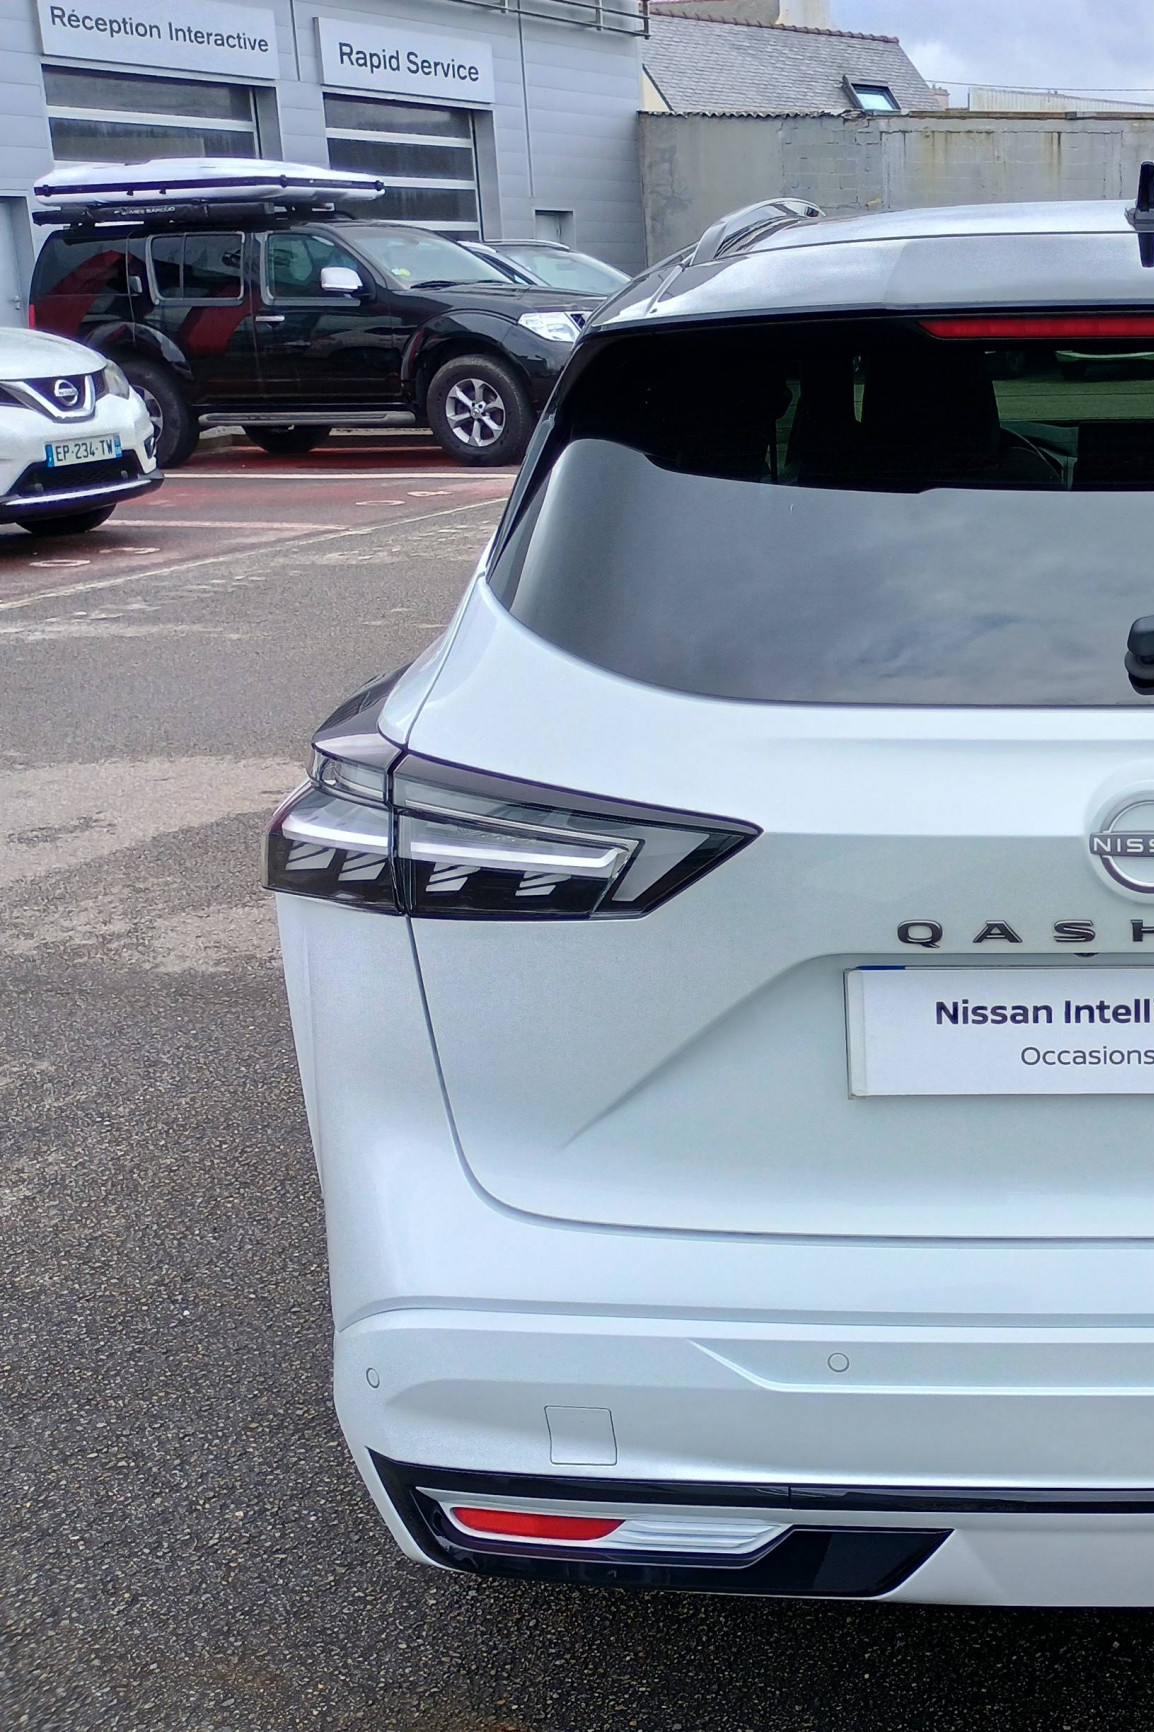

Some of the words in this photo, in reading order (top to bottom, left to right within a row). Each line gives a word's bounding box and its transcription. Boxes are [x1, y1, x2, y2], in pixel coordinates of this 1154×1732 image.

[50, 6, 161, 38] Réception
[168, 22, 269, 52] Interactive
[339, 42, 401, 74] Rapid
[406, 51, 480, 82] Service
[55, 439, 113, 462] EP-234-TW
[935, 1000, 1054, 1026] Nissan
